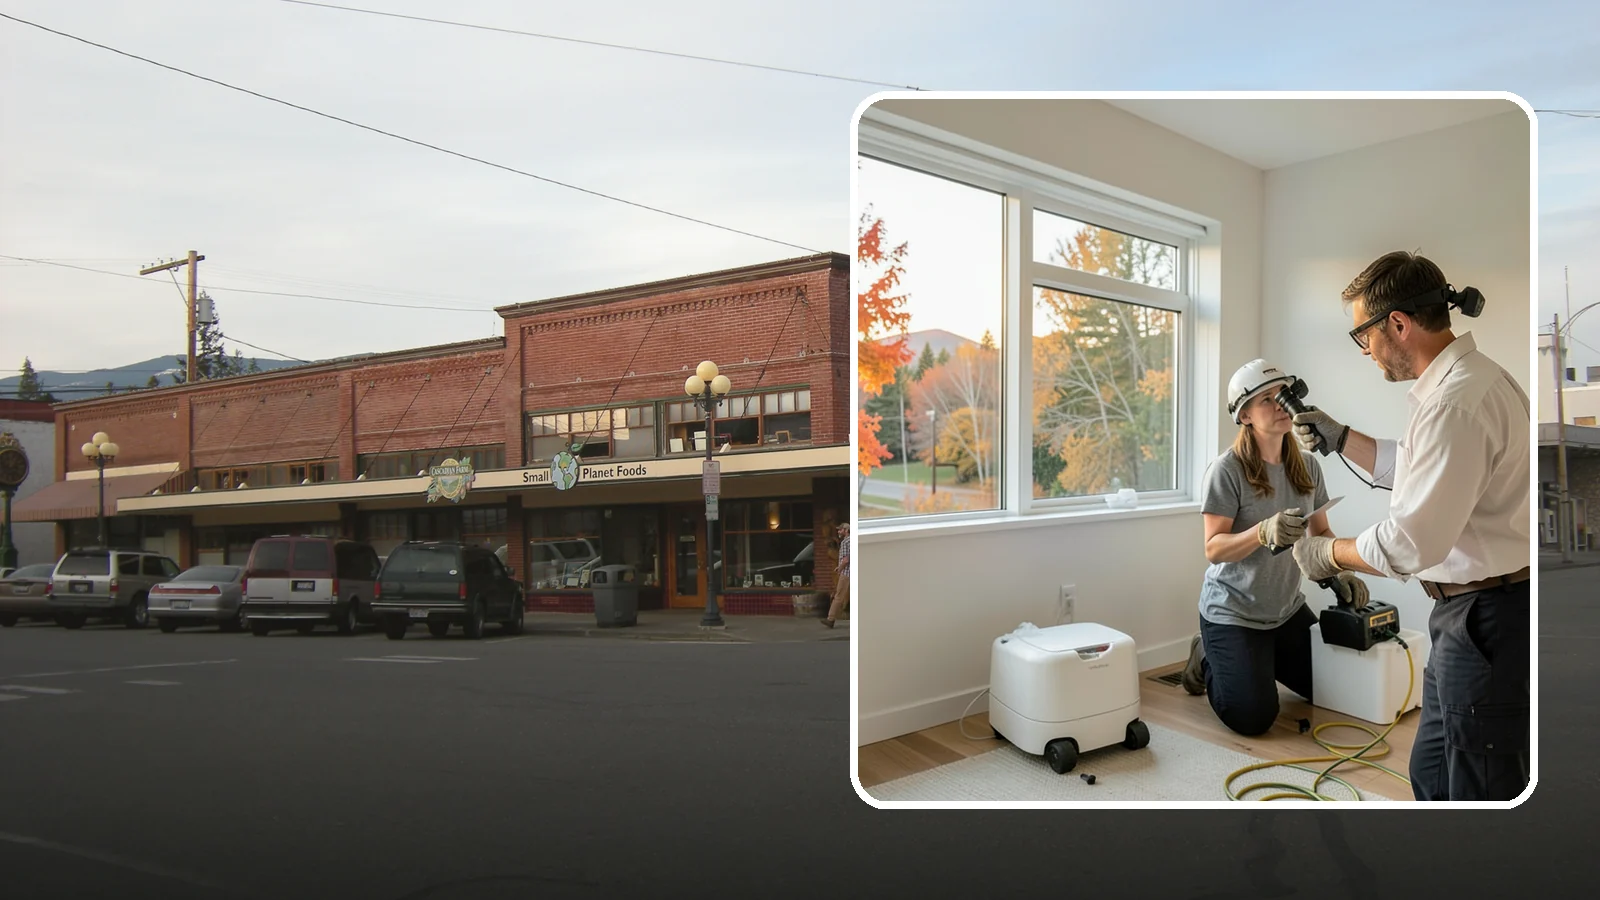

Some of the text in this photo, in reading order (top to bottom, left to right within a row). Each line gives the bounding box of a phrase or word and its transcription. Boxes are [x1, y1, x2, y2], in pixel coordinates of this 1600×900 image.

[523, 464, 647, 483] Small Planet Foods
